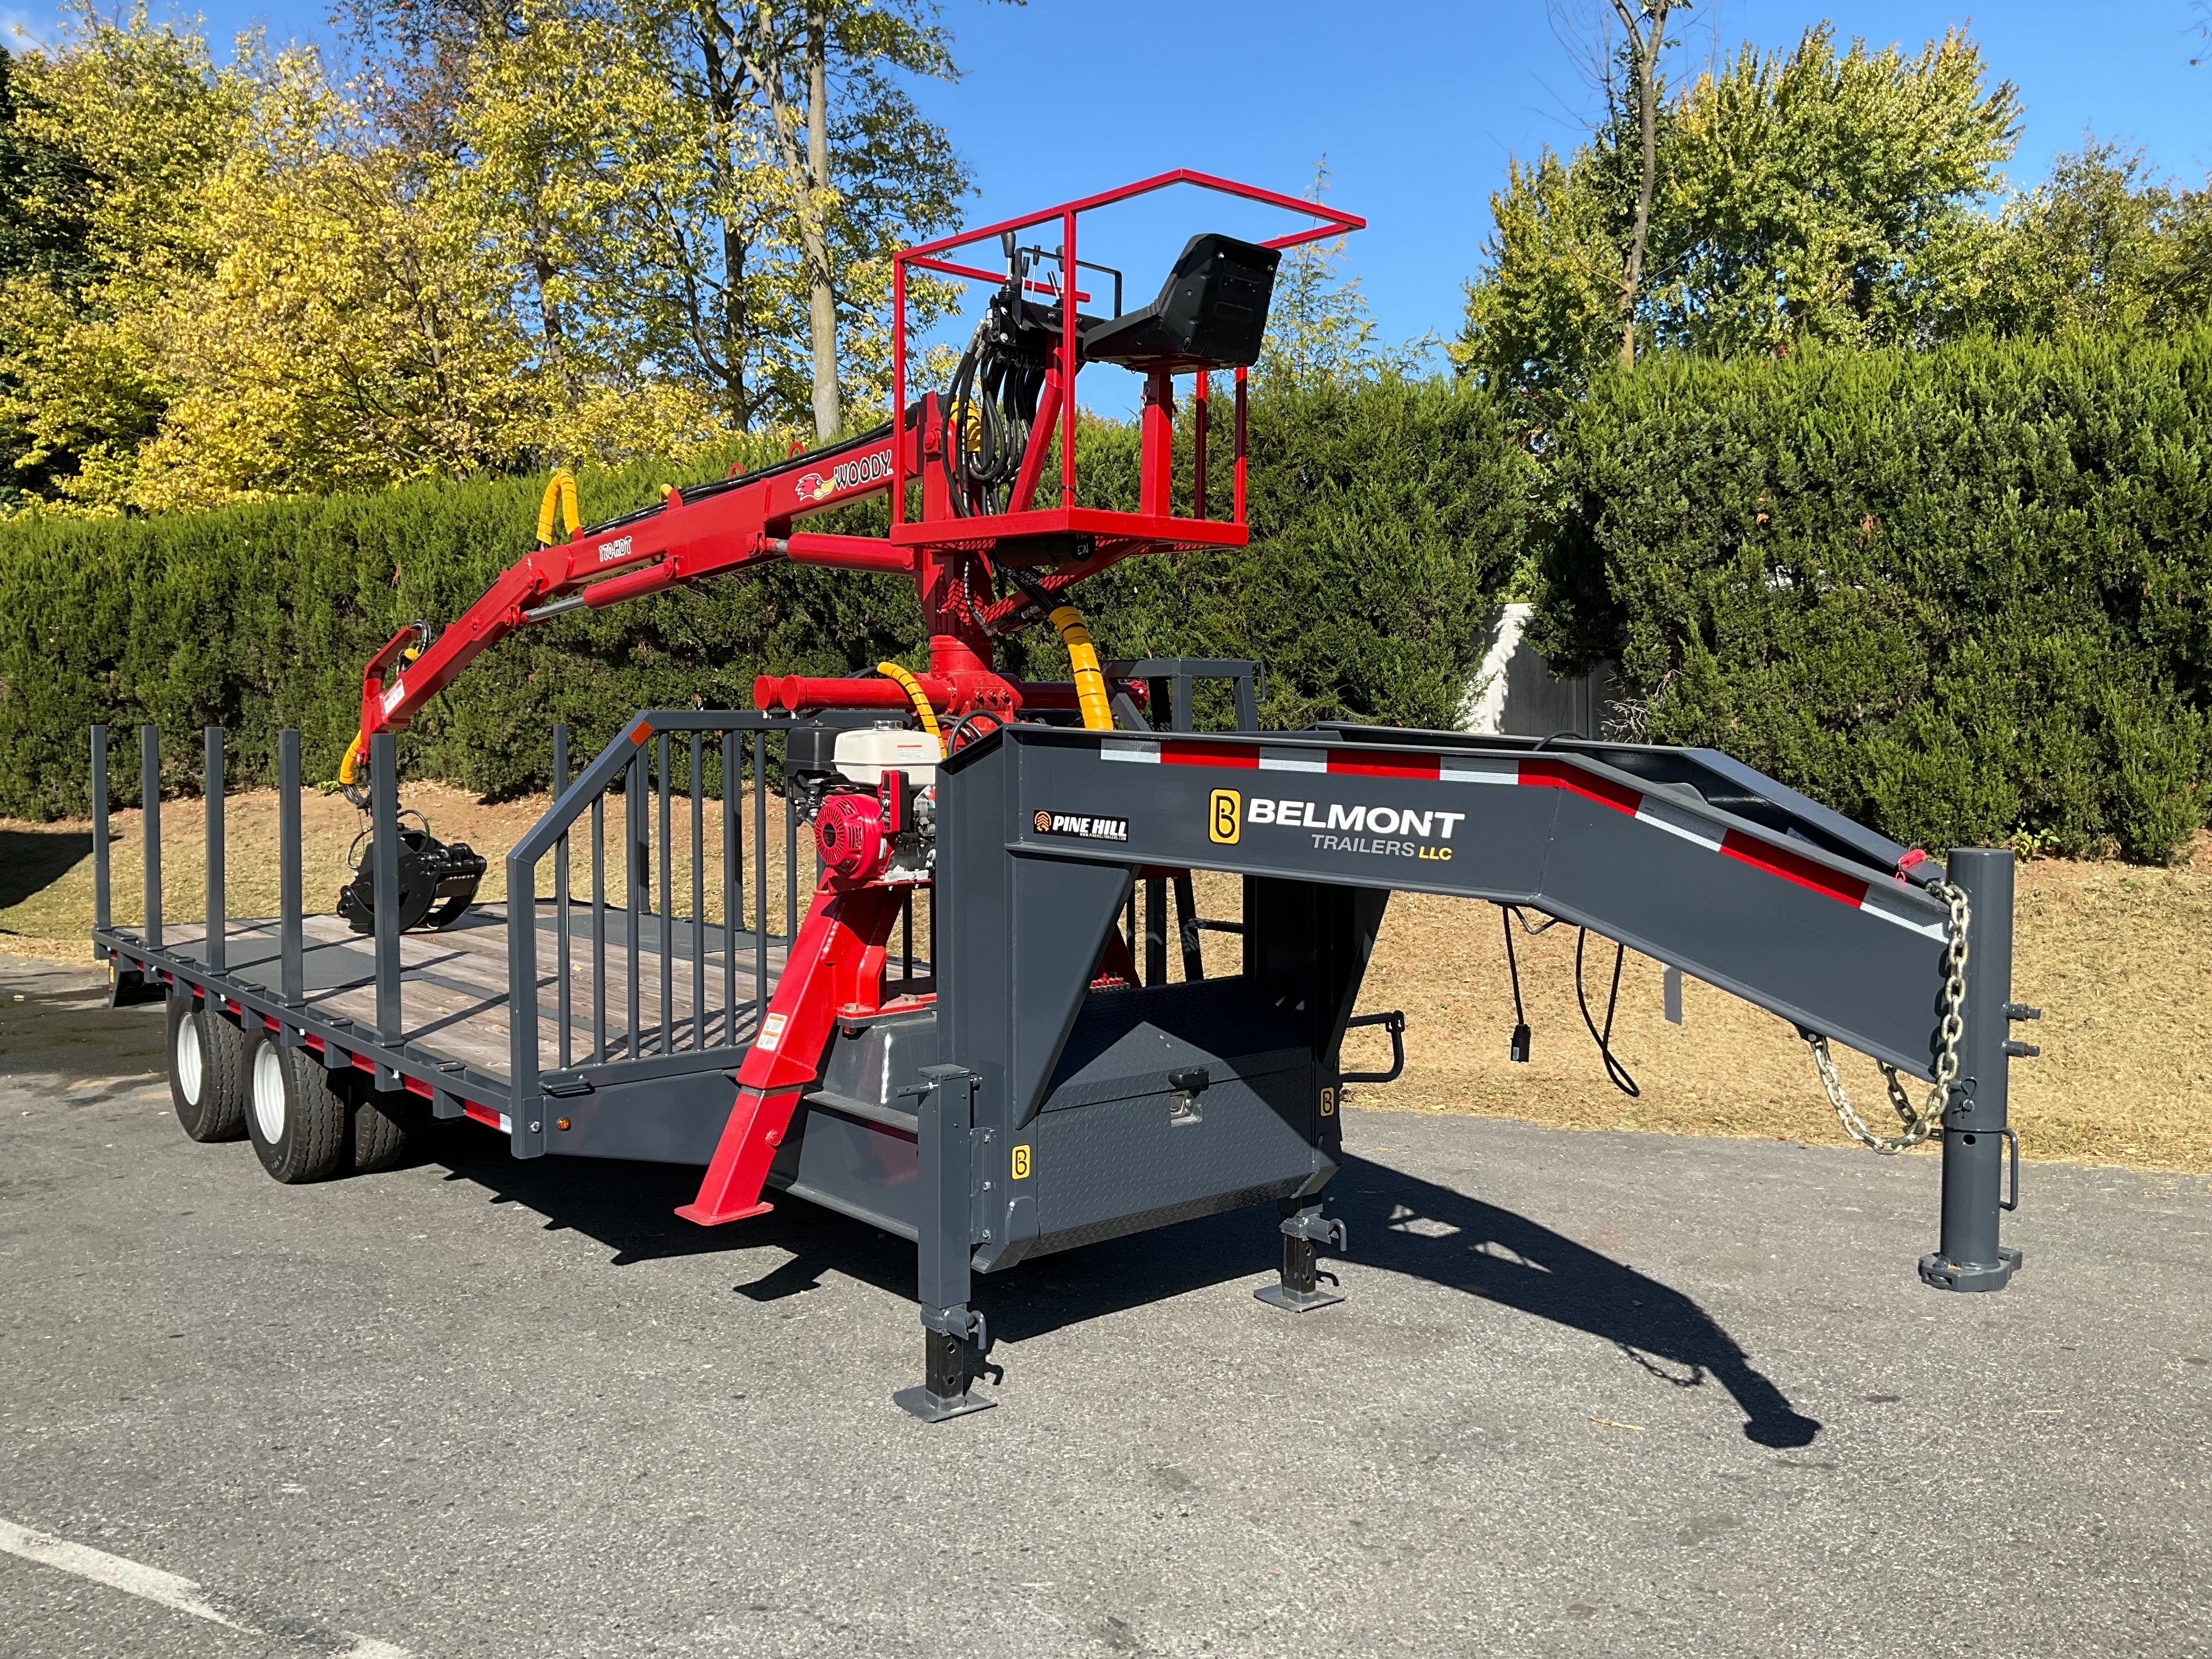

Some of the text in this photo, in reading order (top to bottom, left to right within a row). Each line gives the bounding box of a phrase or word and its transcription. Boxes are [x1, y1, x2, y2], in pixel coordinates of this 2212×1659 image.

[834, 449, 891, 491] WOODY
[1052, 815, 1127, 837] PINE HILL
[1248, 798, 1465, 838] BELMONT
[1311, 834, 1453, 861] TRAILERS LLC
